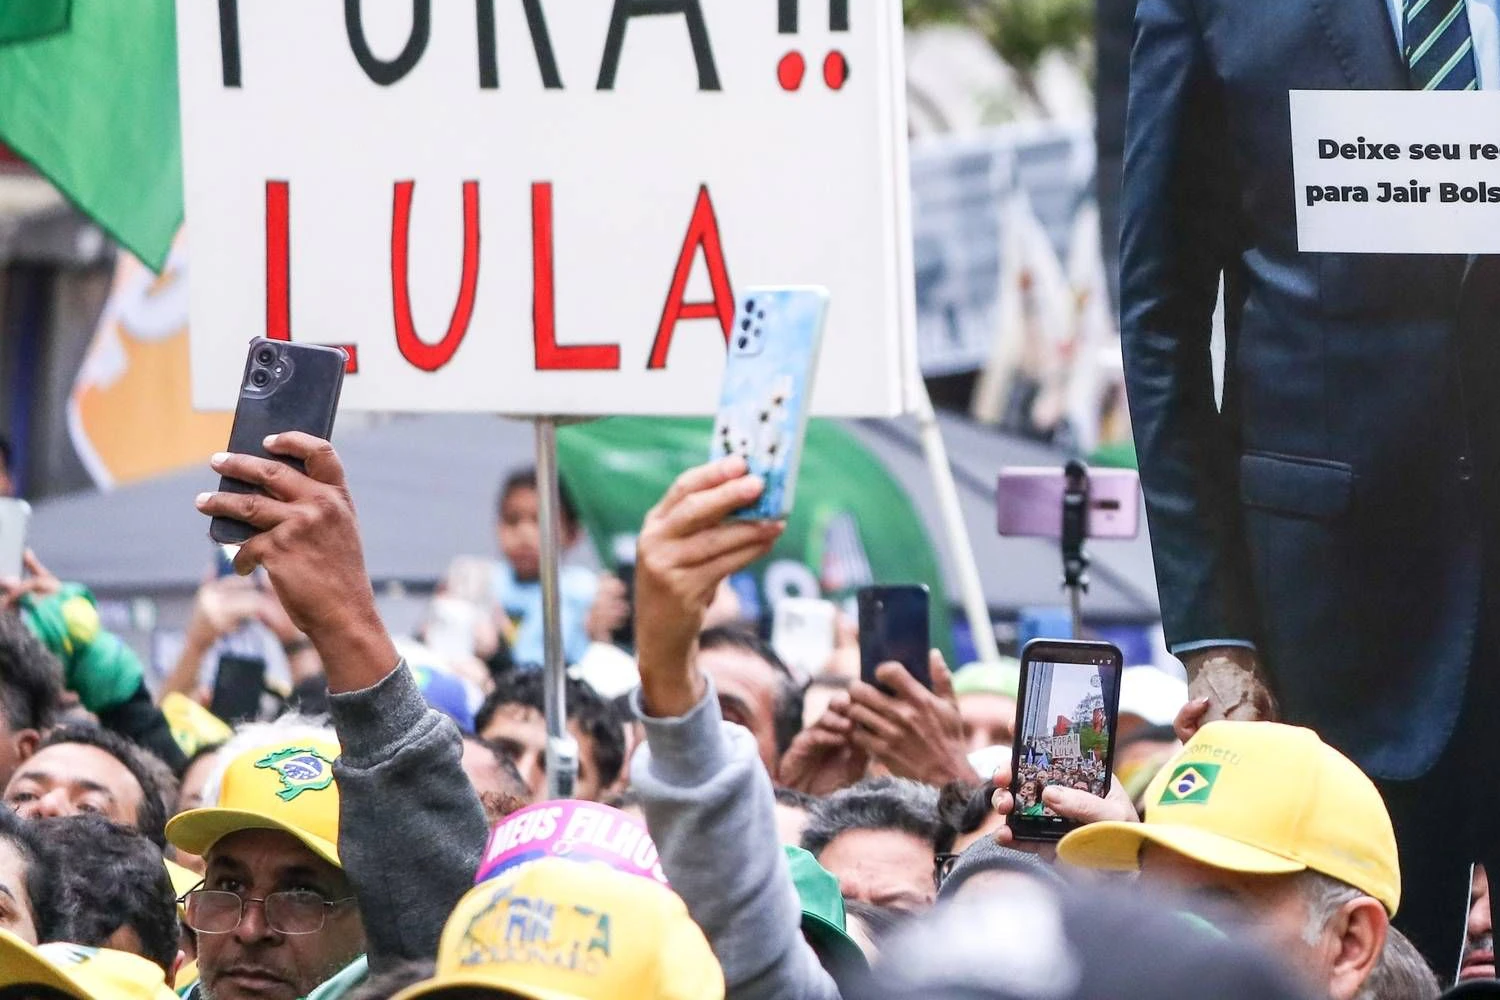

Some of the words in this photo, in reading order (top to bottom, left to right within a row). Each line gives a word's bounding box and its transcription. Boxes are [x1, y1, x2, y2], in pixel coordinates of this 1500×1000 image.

[1317, 136, 1401, 161] Deixe
[1408, 143, 1461, 161] seu
[1305, 185, 1369, 207] para
[1376, 179, 1431, 203] Jair
[265, 180, 737, 374] LULA
